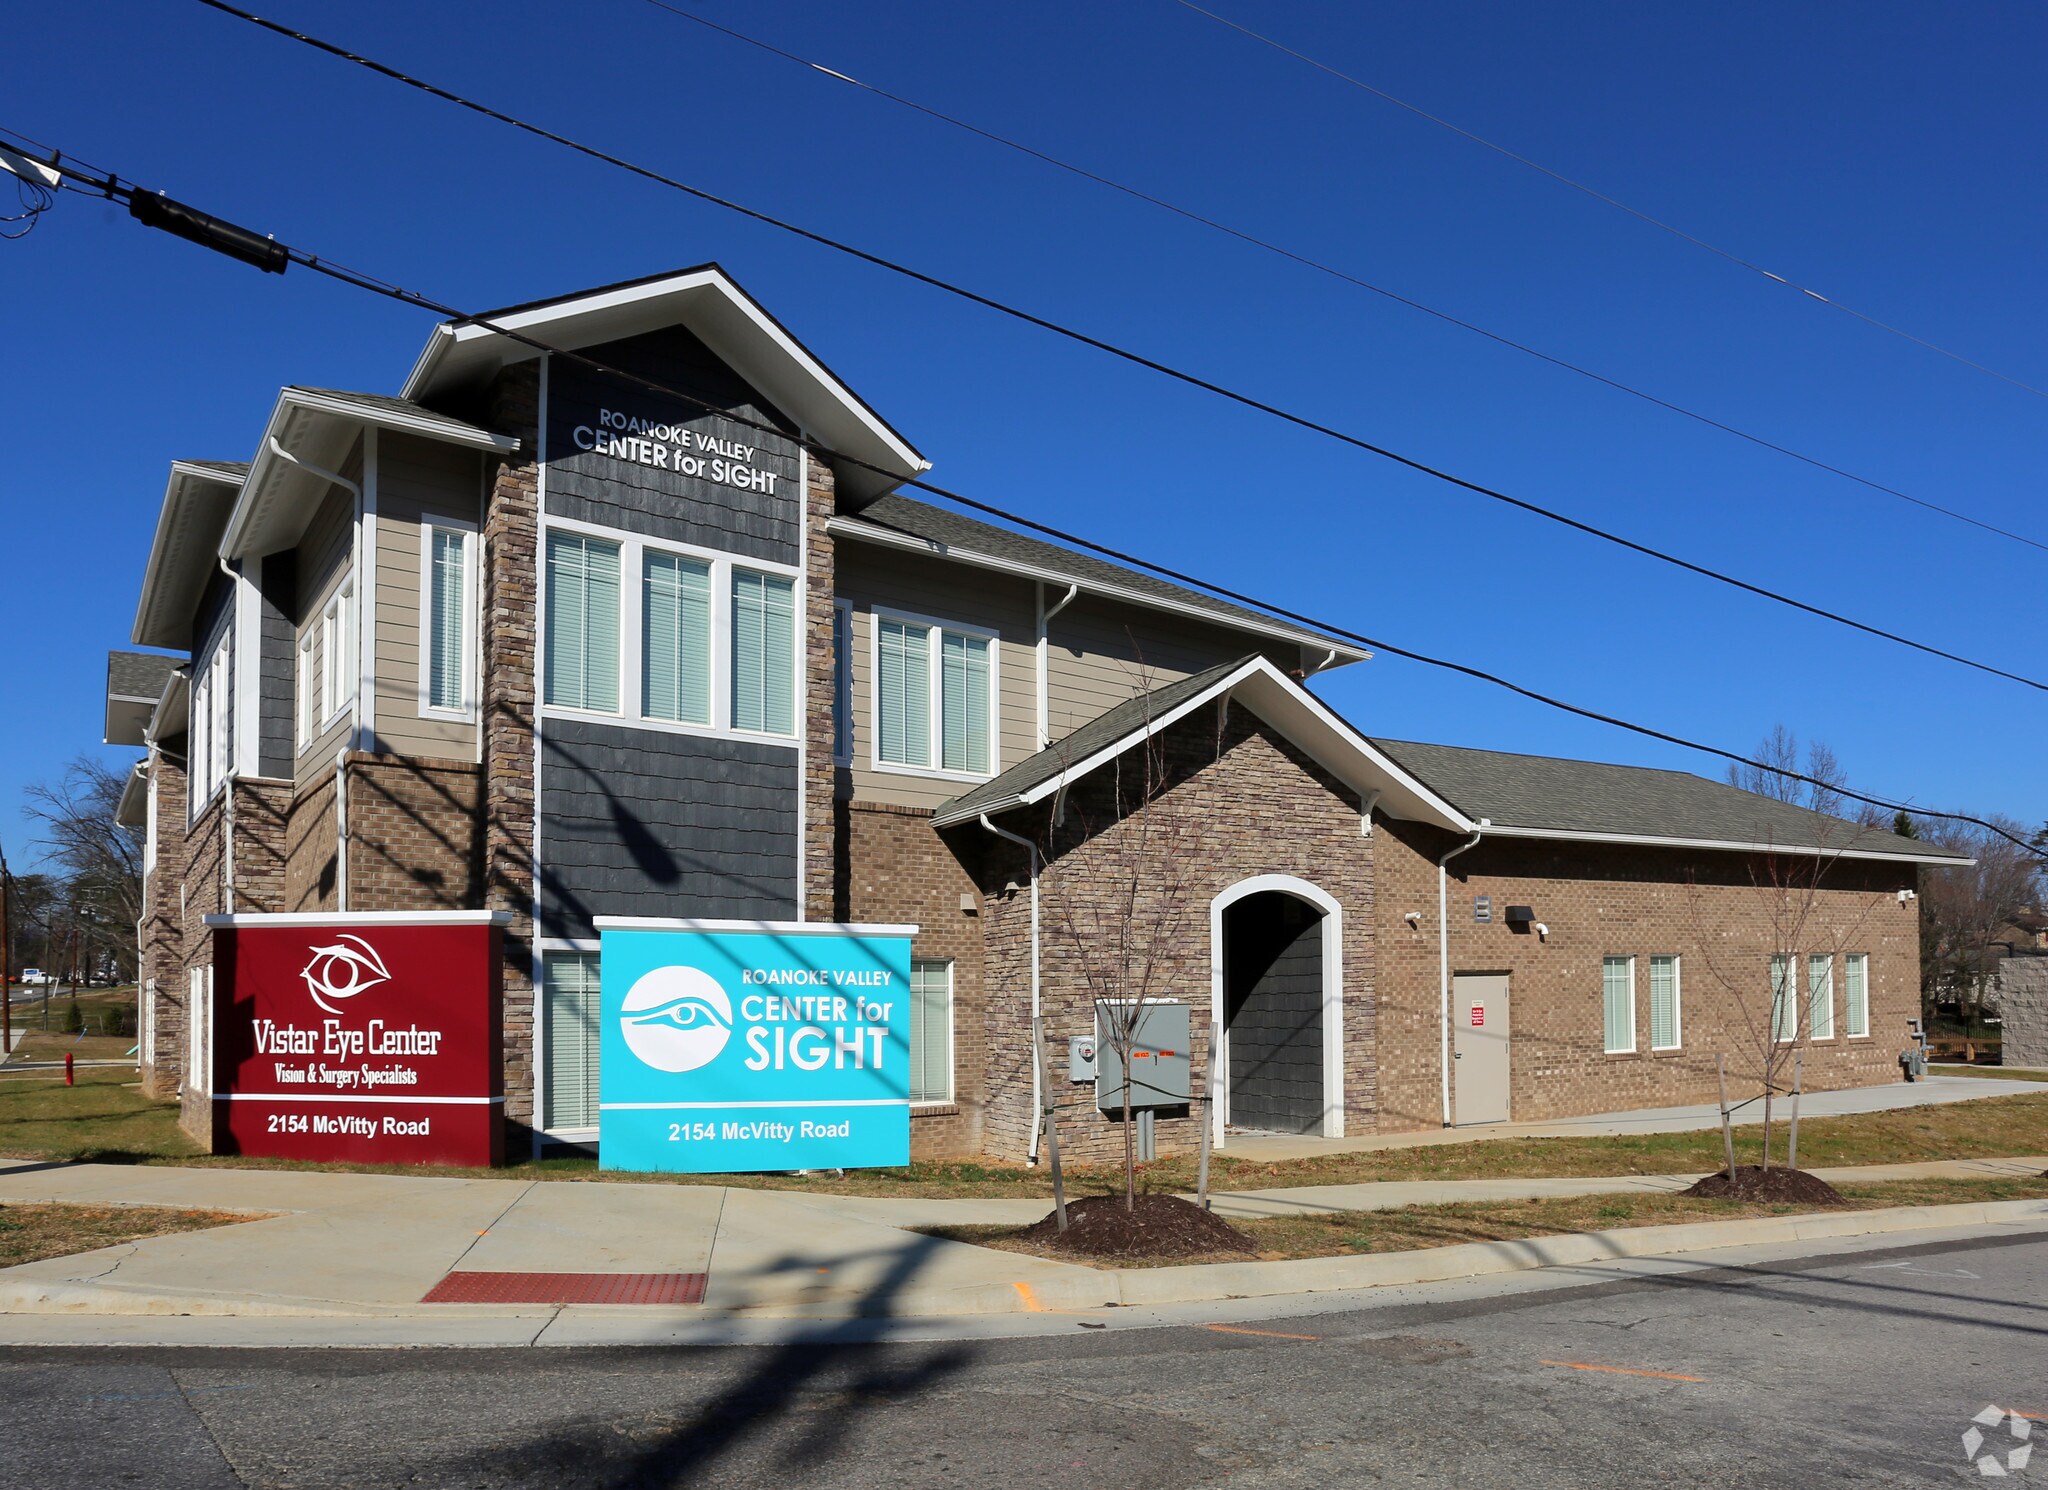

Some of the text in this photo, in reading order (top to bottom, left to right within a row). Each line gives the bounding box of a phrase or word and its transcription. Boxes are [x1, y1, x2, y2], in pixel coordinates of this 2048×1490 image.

[600, 408, 755, 463] ROANOKE VALLEY
[573, 425, 778, 494] CENTER for SIGHT
[742, 968, 892, 986] ROANOKE VALLEY
[741, 995, 893, 1021] CENTER for
[252, 1019, 441, 1063] Vistar Eye Center
[744, 1025, 889, 1071] SIGHT
[275, 1062, 417, 1088] Vision & Surgery Specialists
[267, 1115, 430, 1138] 2154 McVitty Road
[668, 1120, 849, 1143] 2154 McVitty Road
